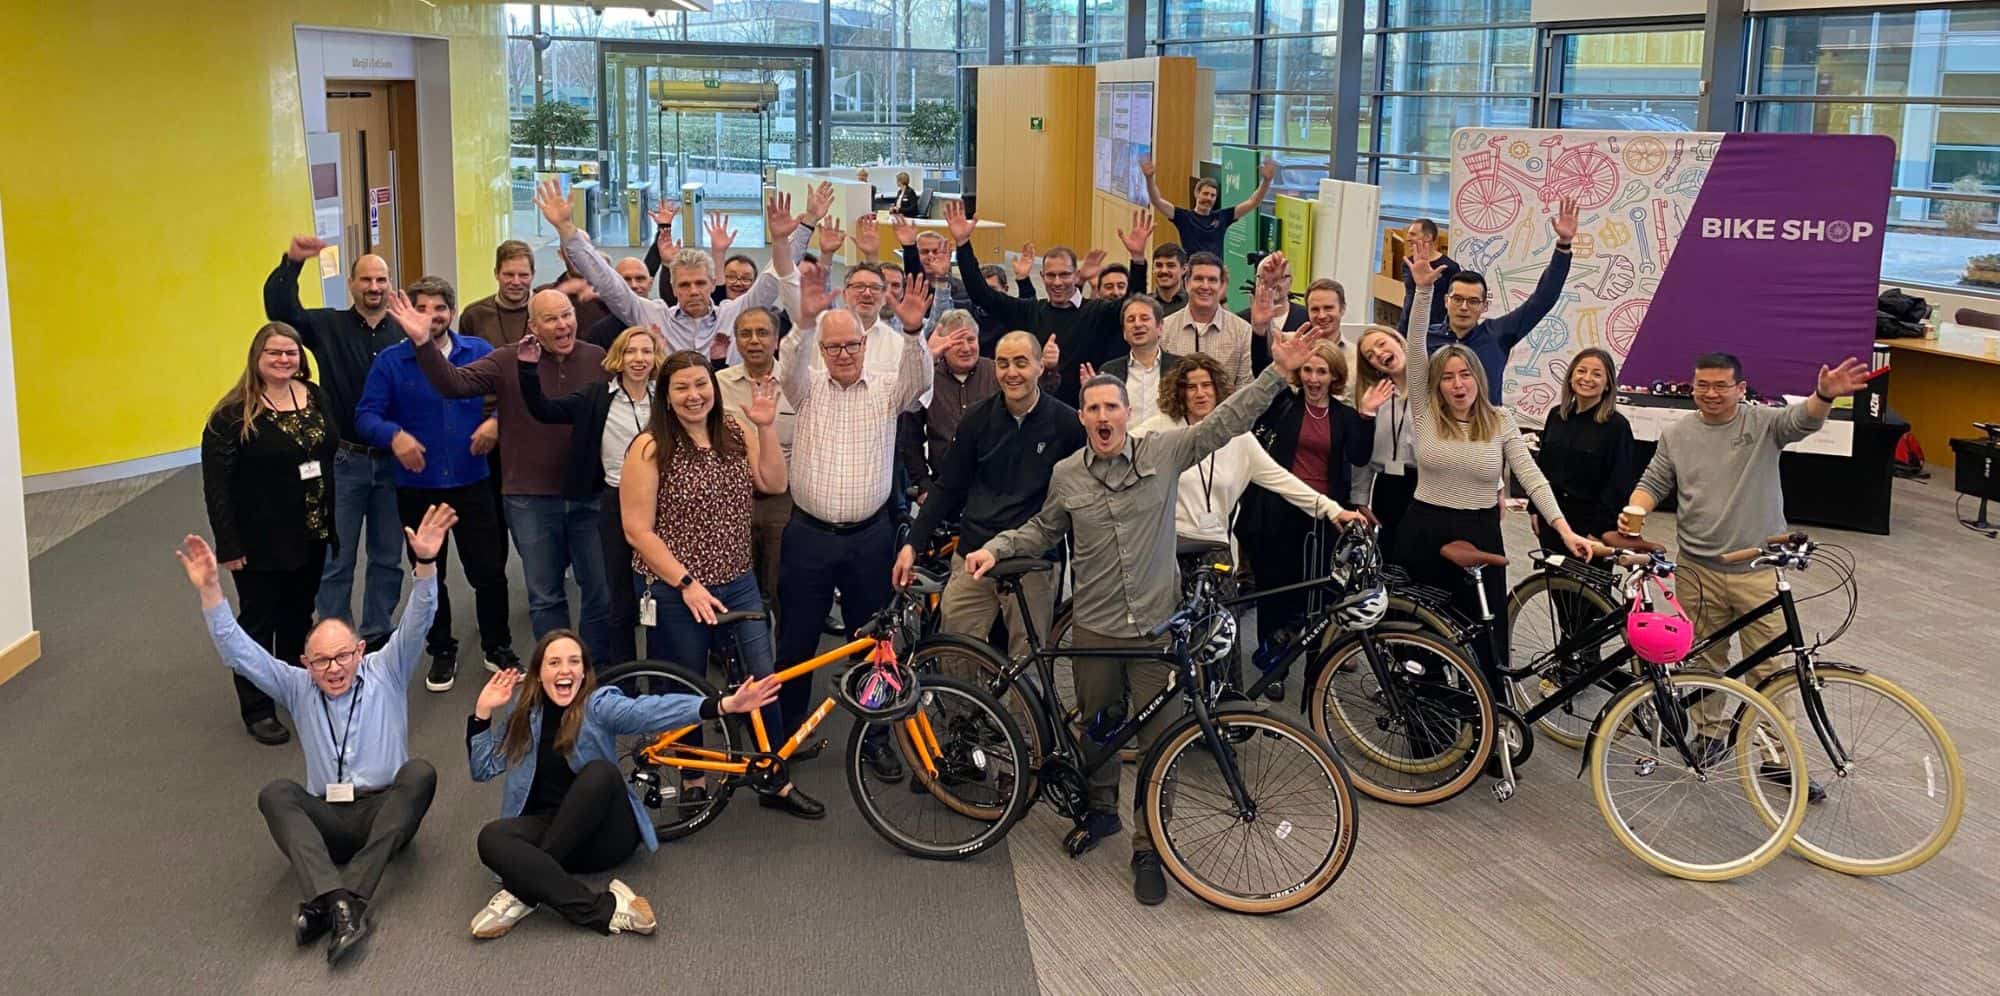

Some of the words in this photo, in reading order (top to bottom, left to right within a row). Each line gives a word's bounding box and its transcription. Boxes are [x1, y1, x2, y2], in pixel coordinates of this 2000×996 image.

[1702, 217, 1776, 240] BIKE
[1781, 219, 1874, 243] SHOP
[1301, 618, 1329, 646] RALEIGH
[1138, 694, 1164, 722] RALEIGH
